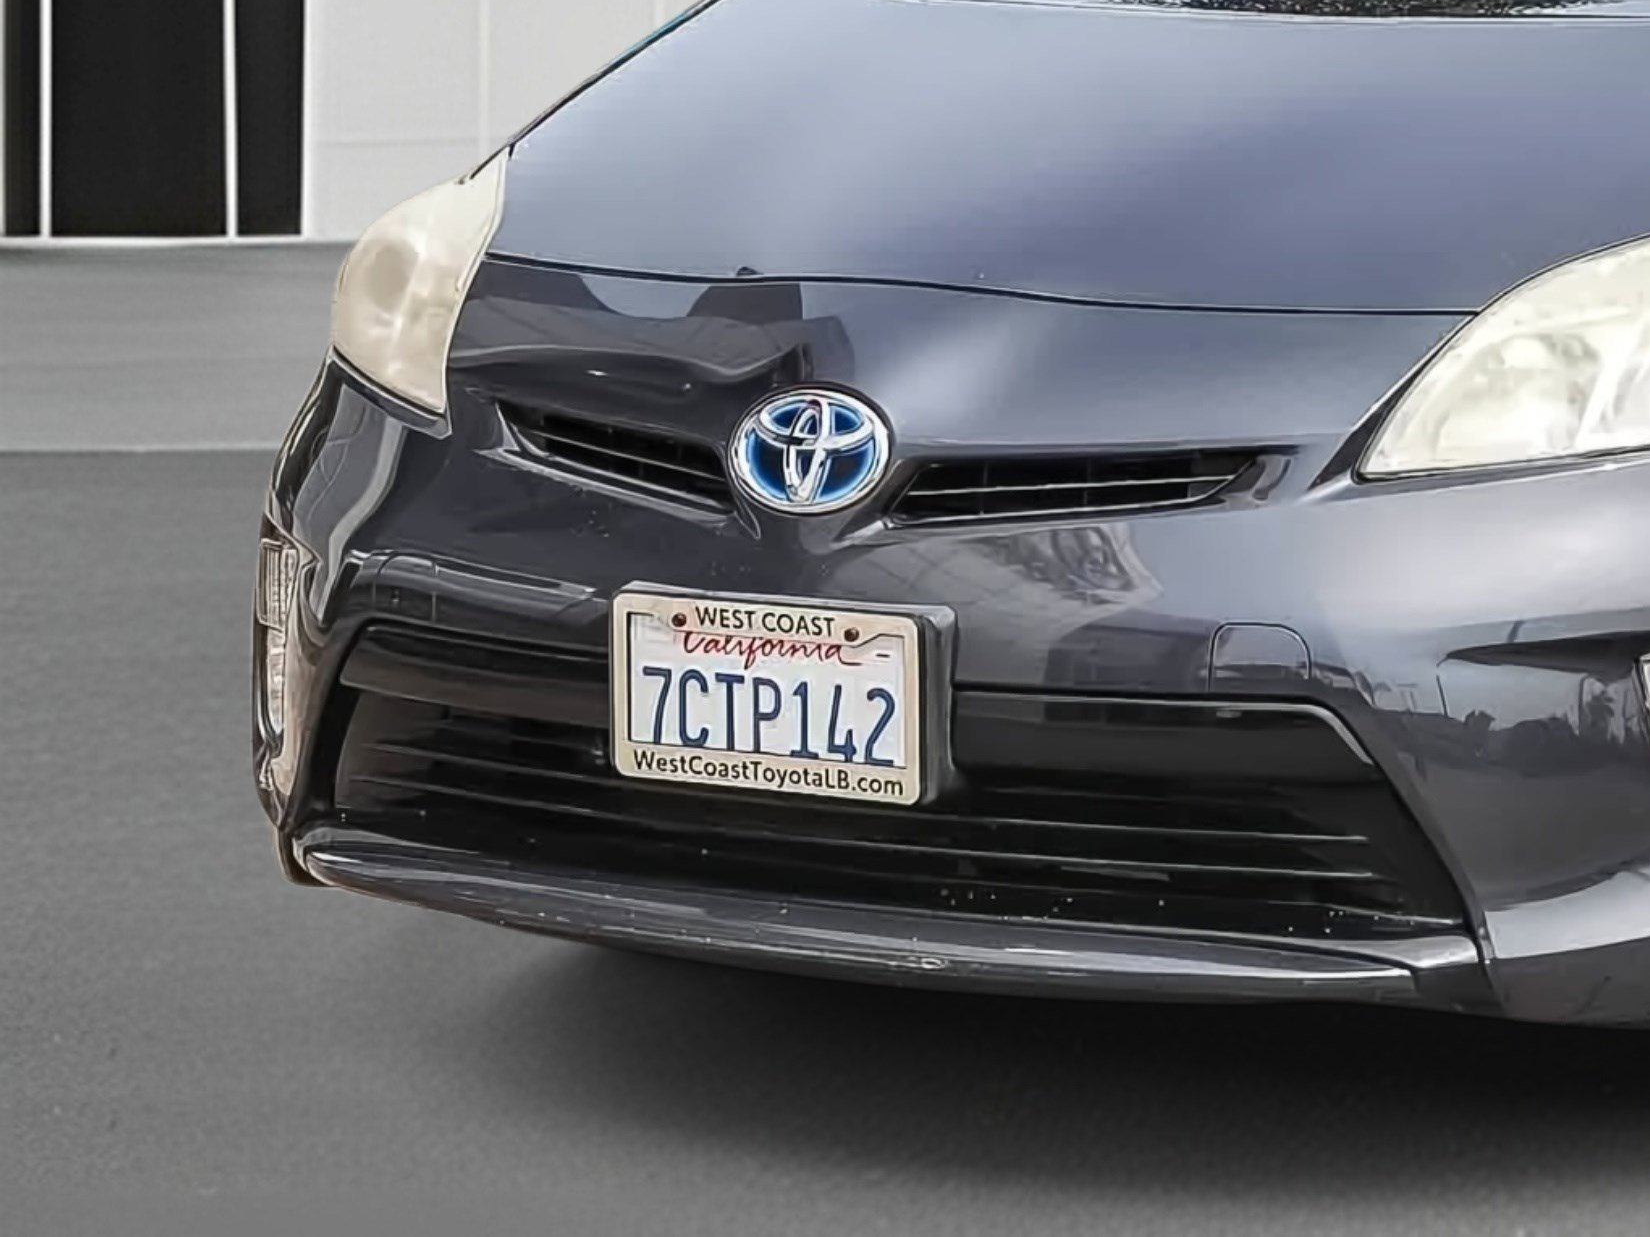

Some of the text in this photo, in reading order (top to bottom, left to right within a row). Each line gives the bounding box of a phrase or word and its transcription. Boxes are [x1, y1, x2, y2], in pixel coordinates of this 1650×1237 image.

[695, 606, 836, 637] WEST COAST
[682, 628, 863, 670] California
[642, 666, 896, 767] 7CTP142
[633, 749, 904, 797] WestCoastToyotaLB.com
